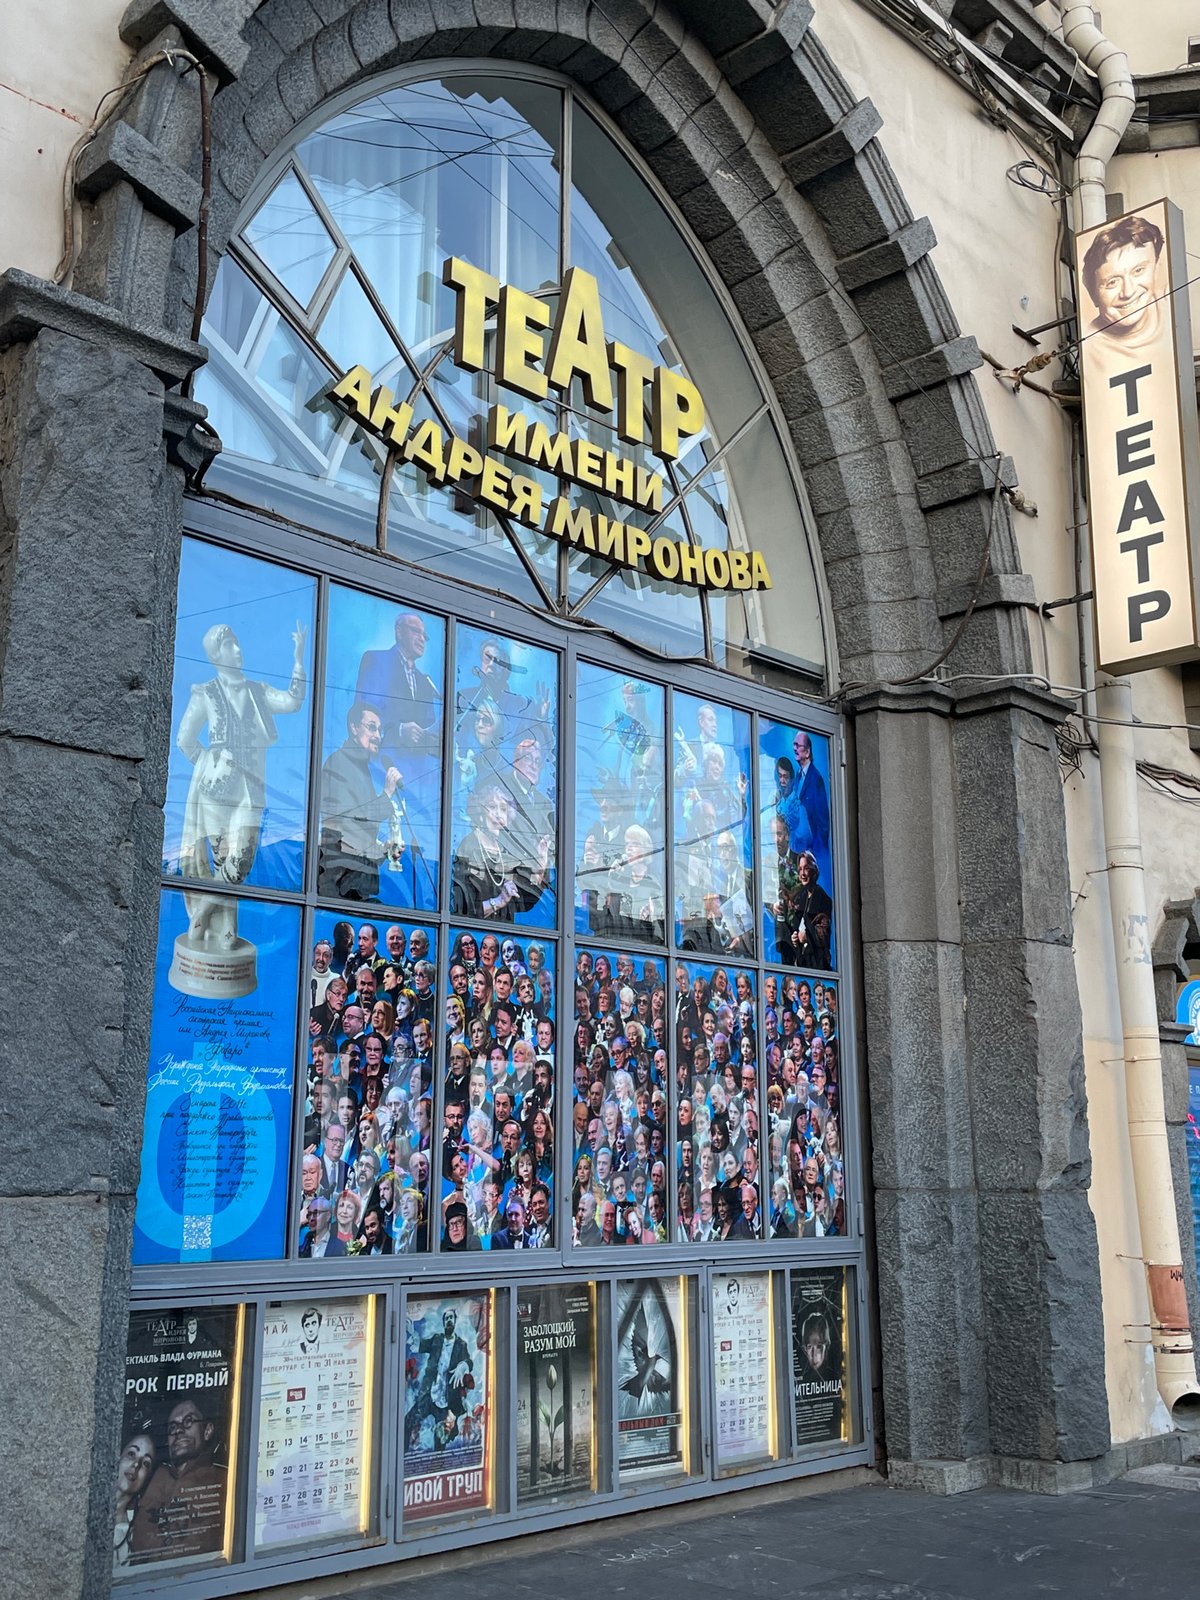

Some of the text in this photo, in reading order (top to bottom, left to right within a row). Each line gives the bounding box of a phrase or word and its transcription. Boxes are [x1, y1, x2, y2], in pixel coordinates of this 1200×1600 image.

[442, 255, 705, 462] ТЕАТР
[488, 403, 664, 515] ИМЕНИ
[327, 365, 773, 590] АНДРЕЯ МИРОНОВА
[1107, 363, 1173, 644] ТЕАТР
[146, 1319, 177, 1337] ТЕАТР
[325, 1316, 355, 1332] ТЕАТР
[523, 1318, 576, 1337] ЗАБОЛОЦКИЙ.
[524, 1331, 576, 1353] РАЗУМ МОЙ
[160, 1352, 185, 1362] ВЛАДА
[186, 1349, 222, 1361] ФУРМАНА
[263, 1363, 297, 1374] РЕПЕРТУАР
[324, 1359, 331, 1367] 31
[125, 1367, 229, 1395] РОК ПЕРВЫЙ
[795, 1379, 843, 1397] ИТЕЛЬНИЦА
[581, 1389, 586, 1399] 7
[518, 1399, 526, 1410] 24
[267, 1440, 275, 1448] 12
[284, 1438, 293, 1446] 13
[300, 1436, 308, 1444] 14
[346, 1429, 353, 1437] 17
[266, 1457, 354, 1477] 19 20 21 22 23 24
[264, 1483, 352, 1505] 26 27 28 29 30 31
[404, 1475, 443, 1507] ИВОЙ
[447, 1470, 483, 1498] ТРУП
